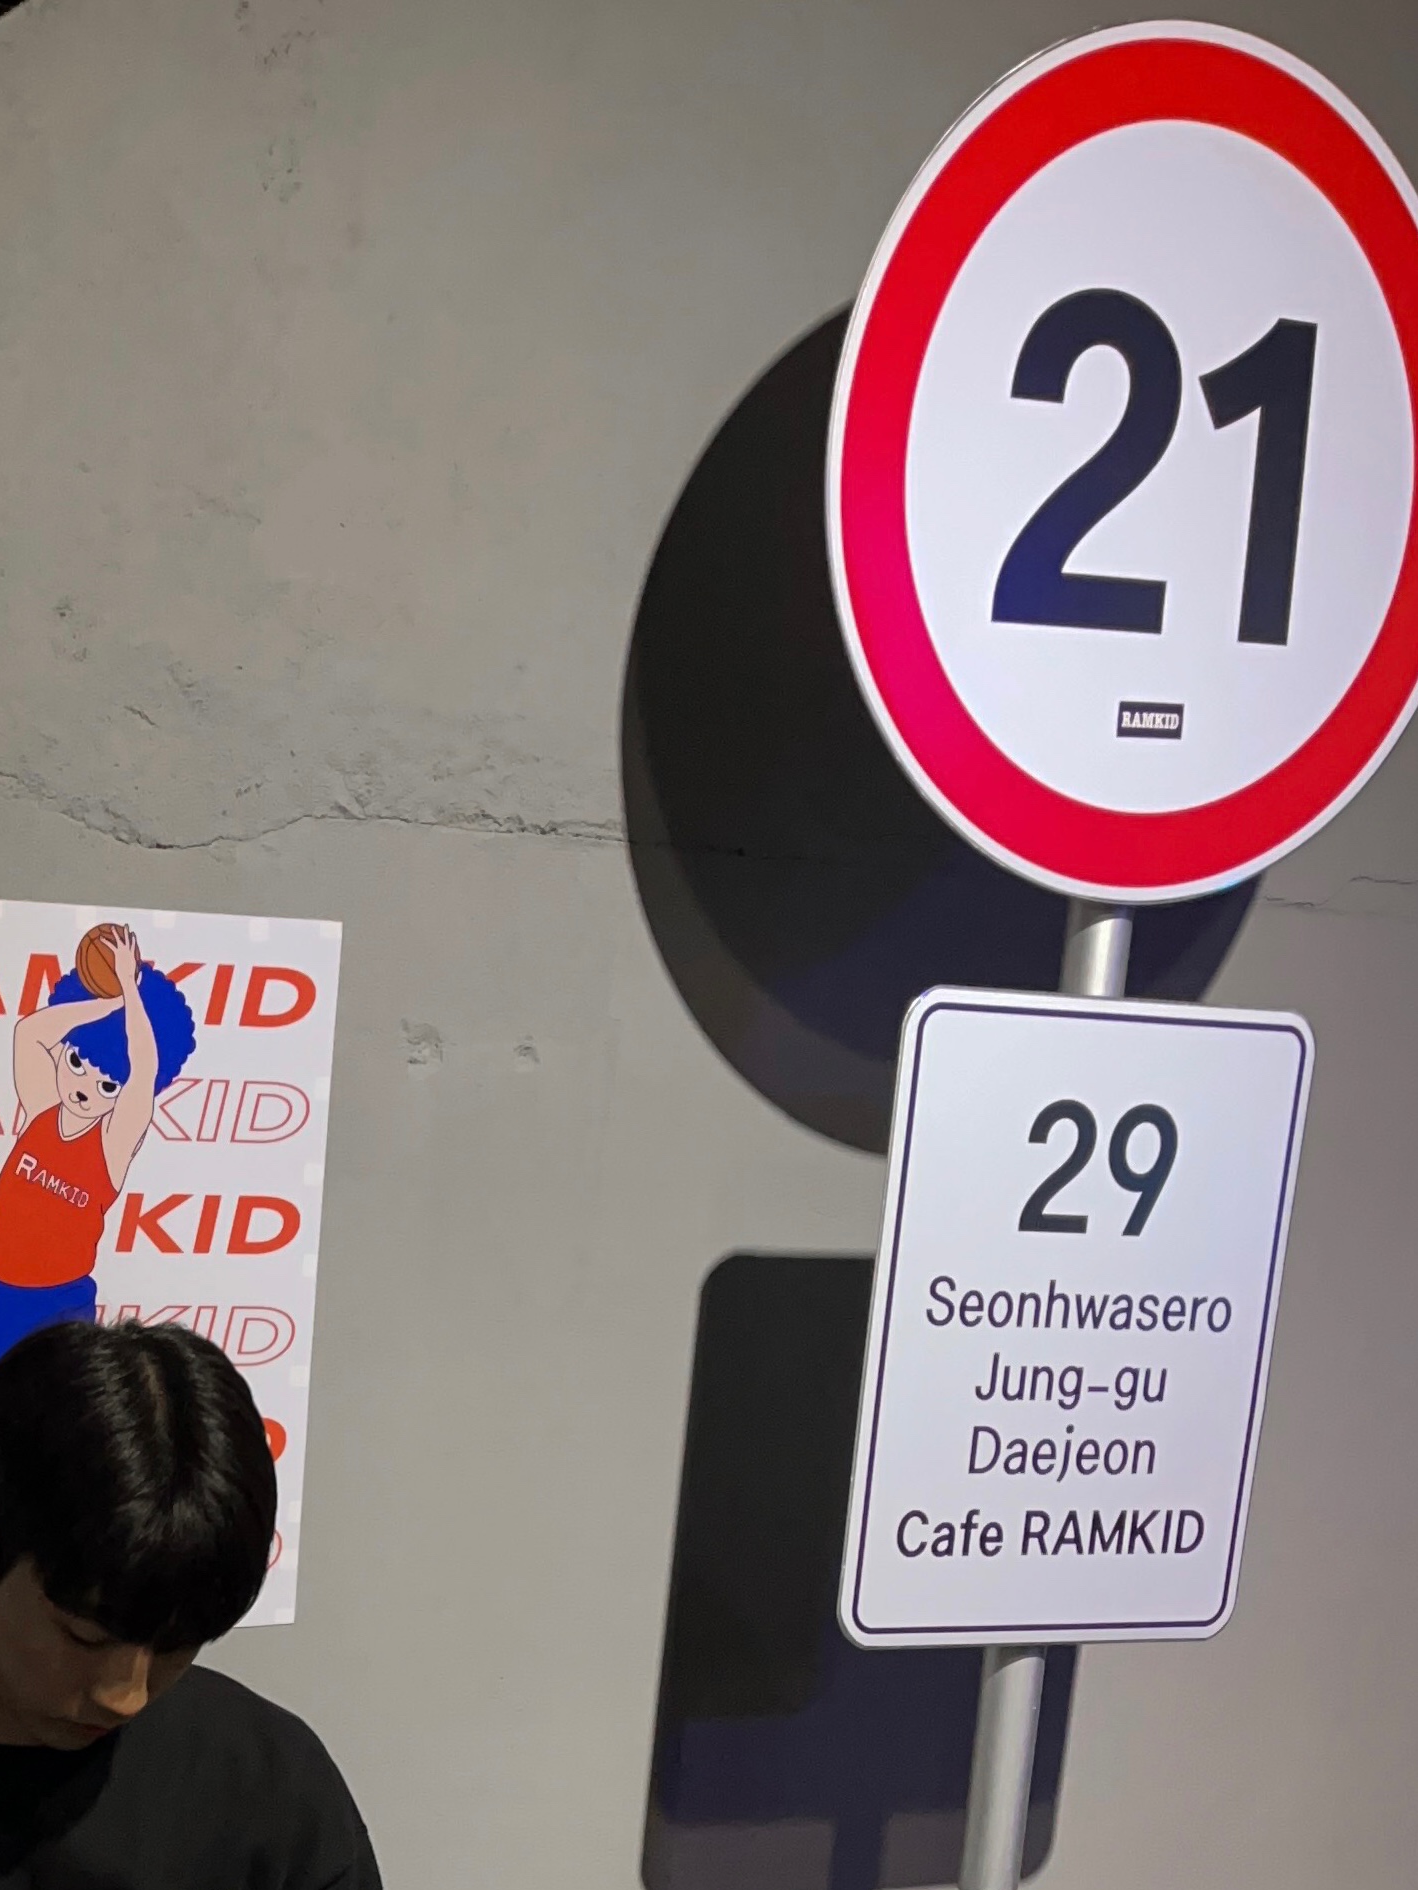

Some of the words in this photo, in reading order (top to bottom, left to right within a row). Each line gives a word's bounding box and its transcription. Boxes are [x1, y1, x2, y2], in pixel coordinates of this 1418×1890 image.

[992, 288, 1318, 646] 21
[1121, 711, 1180, 730] RAMKID
[1019, 1099, 1178, 1237] 29
[926, 1275, 1232, 1333] Seonhwasero
[975, 1352, 1167, 1411] Jung-gu
[968, 1424, 1156, 1483] Daejeon
[896, 1509, 1003, 1558] Cafe
[1022, 1509, 1205, 1556] RAMKID
